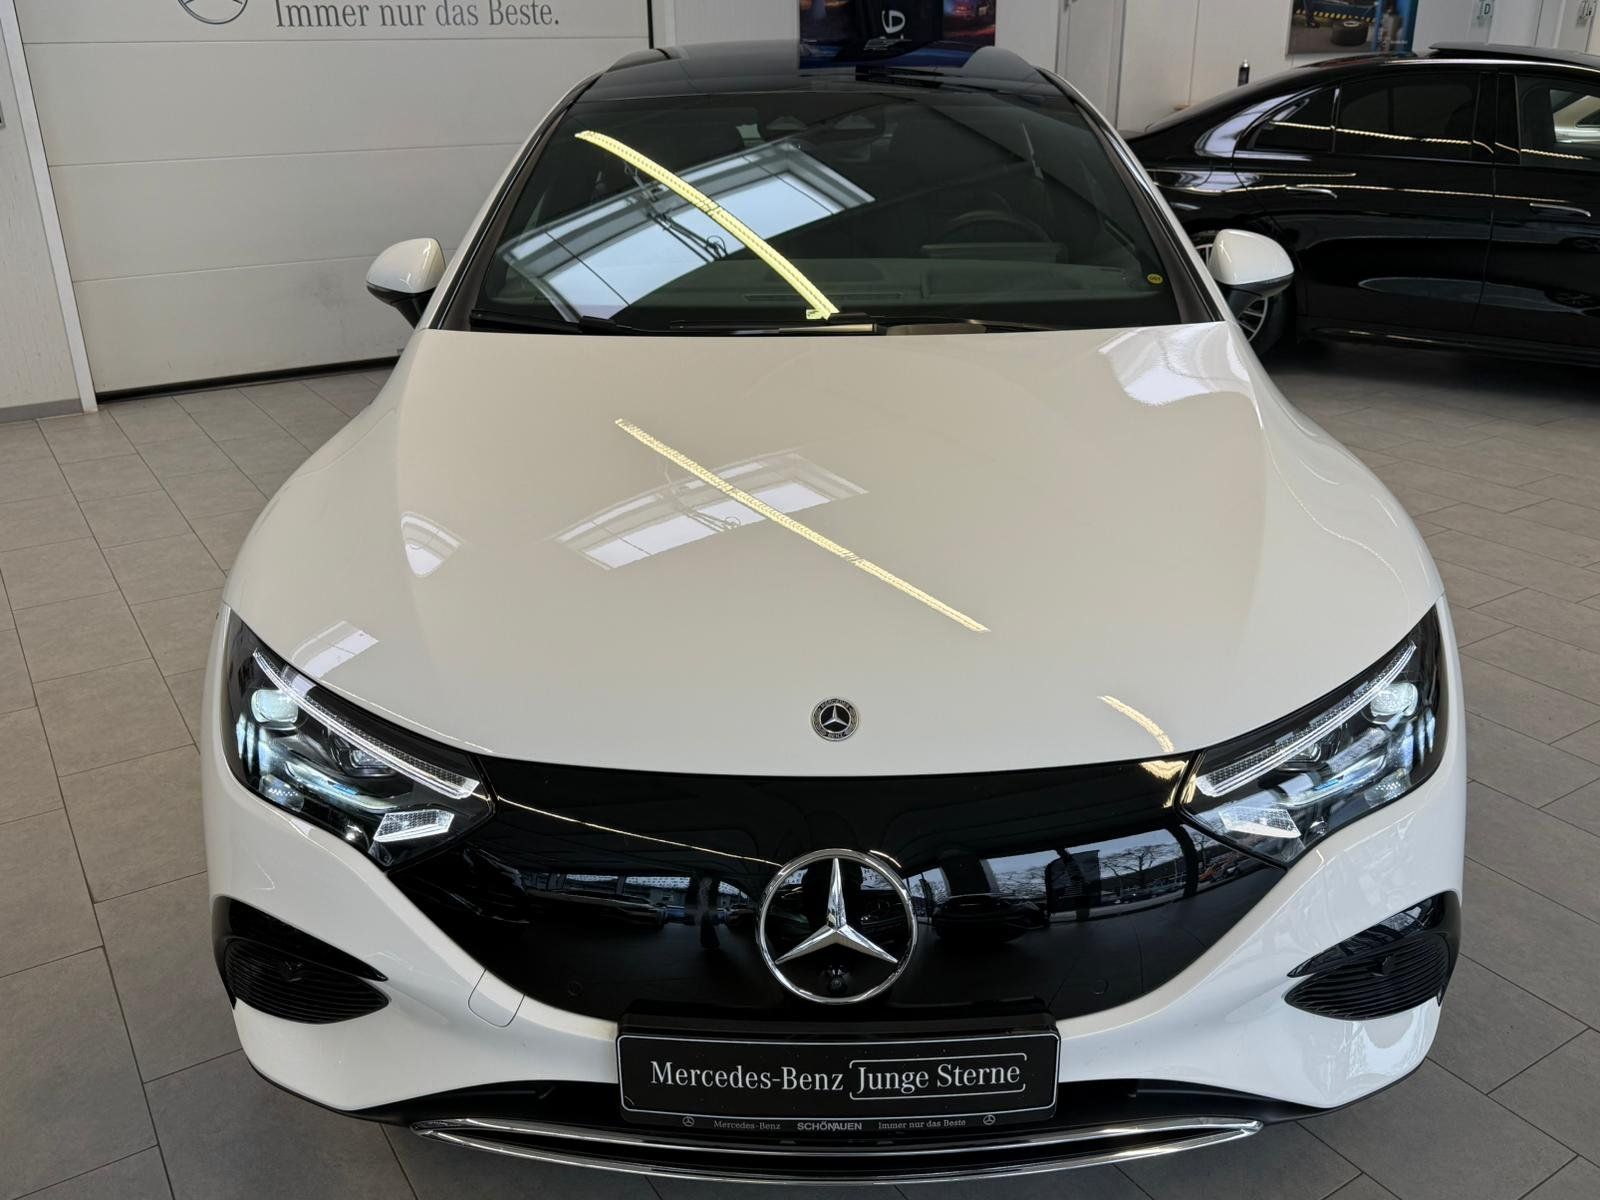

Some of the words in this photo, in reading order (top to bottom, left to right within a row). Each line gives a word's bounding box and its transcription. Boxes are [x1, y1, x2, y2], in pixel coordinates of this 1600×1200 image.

[275, 0, 369, 27] Immer
[379, 4, 426, 26] nur
[435, 0, 479, 26] das
[488, 0, 559, 26] Beste.
[650, 1061, 844, 1091] Mercedes-Benz
[856, 1066, 929, 1094] Junge
[937, 1064, 1020, 1088] Sterne
[713, 1120, 780, 1130] Mercedes-Benz
[926, 1119, 940, 1127] das
